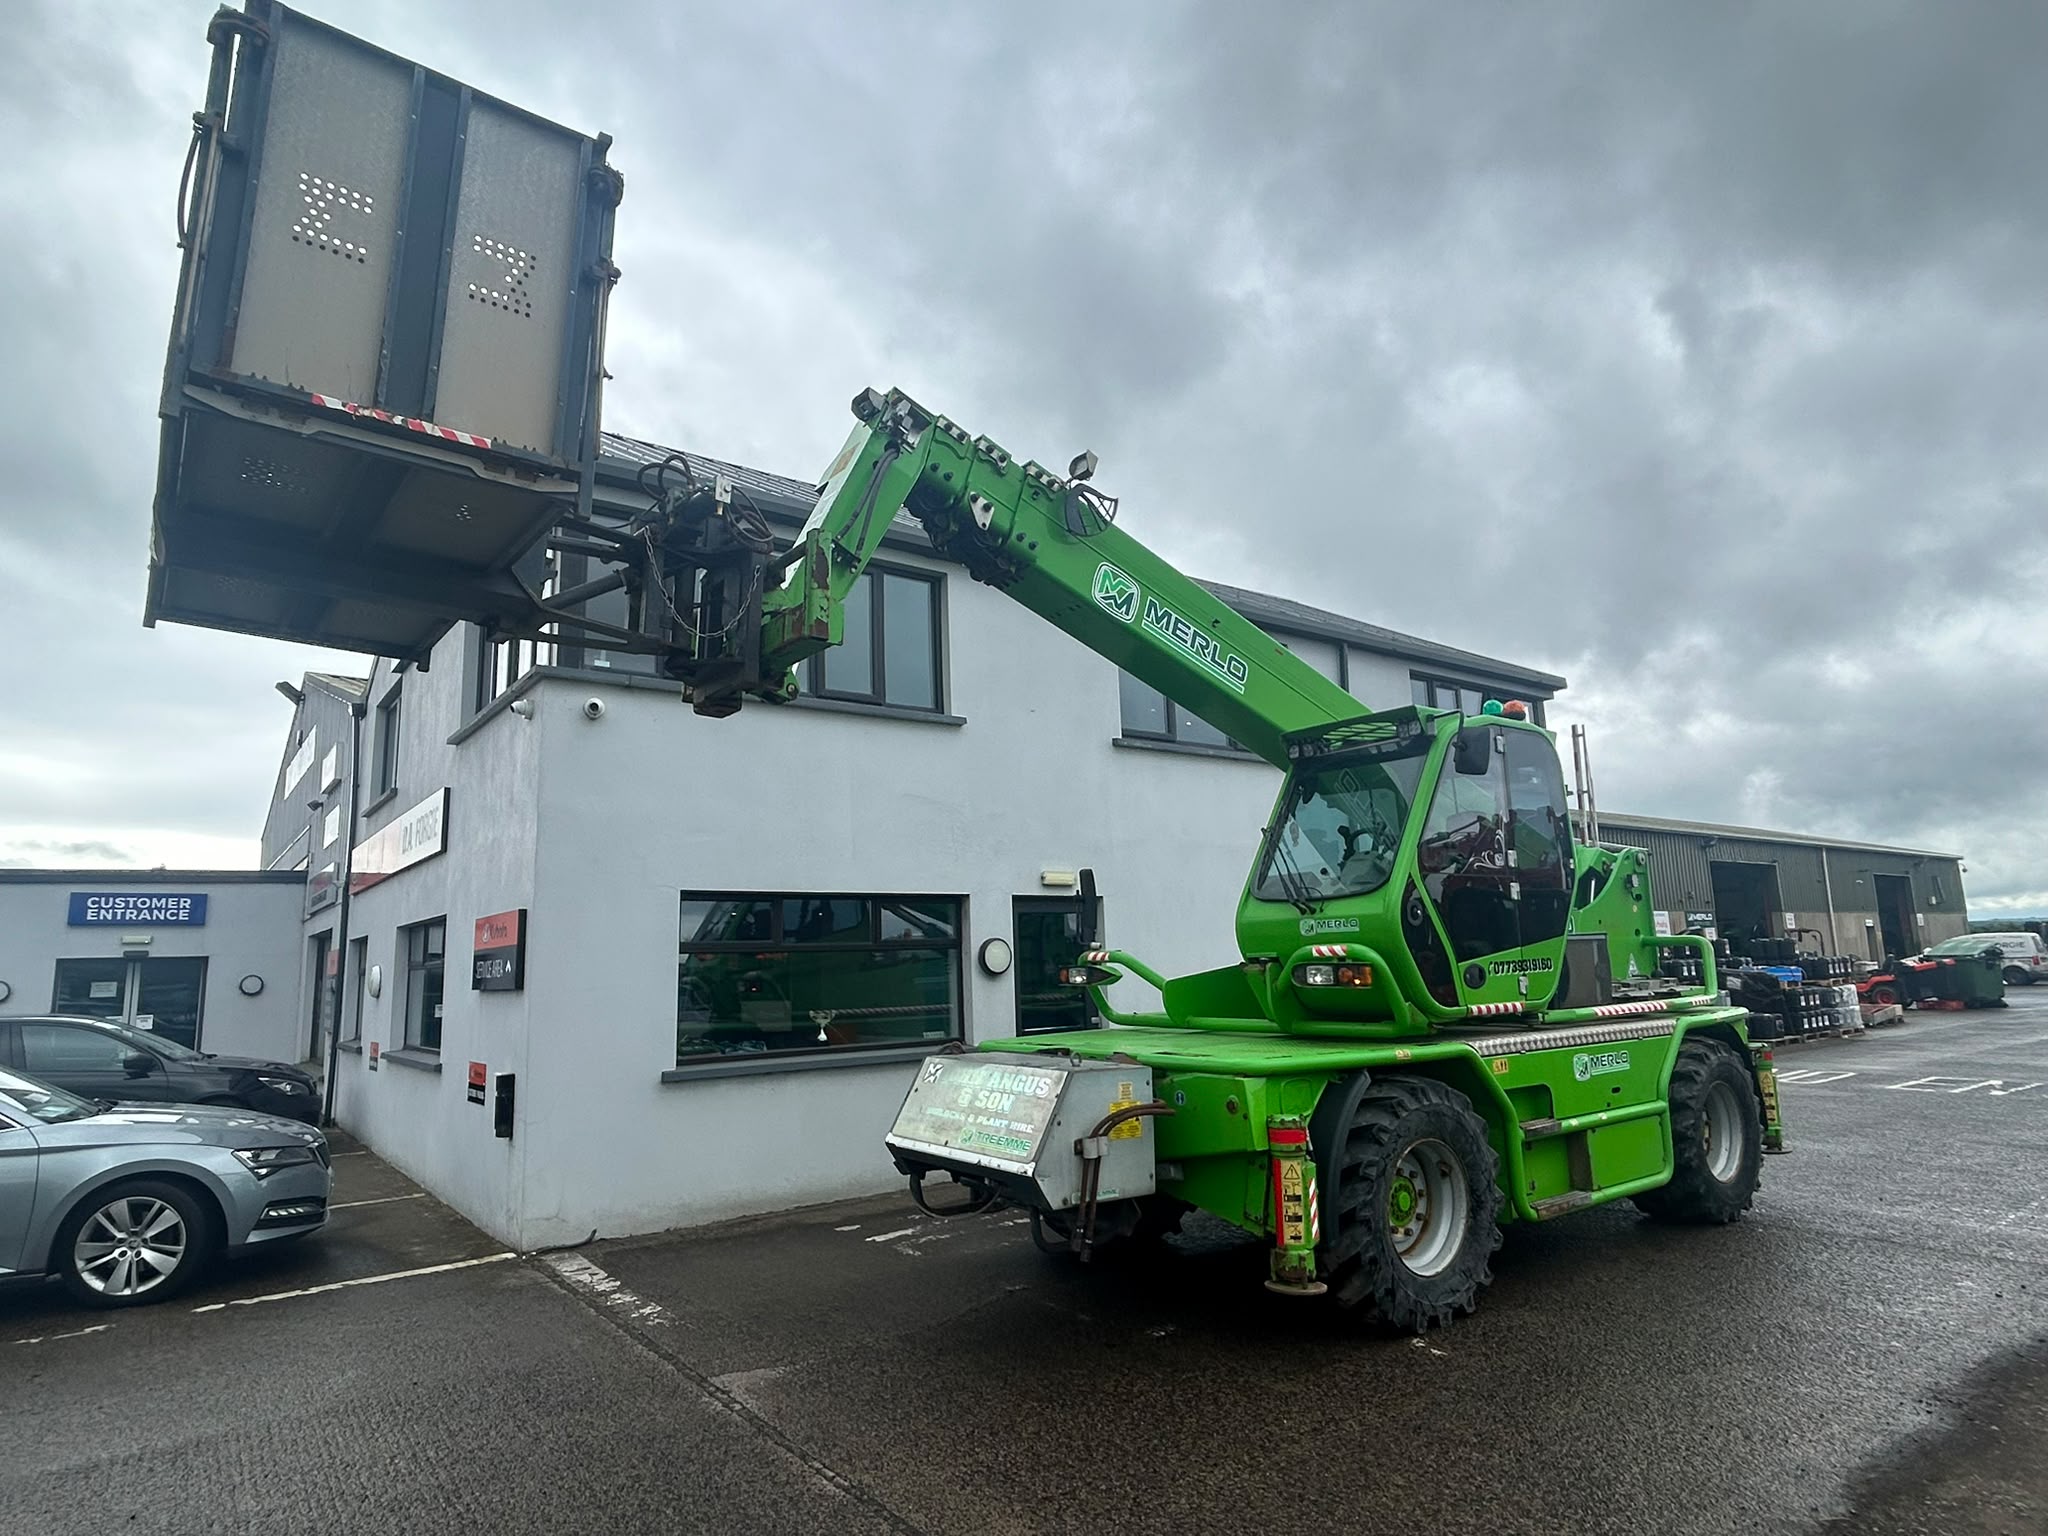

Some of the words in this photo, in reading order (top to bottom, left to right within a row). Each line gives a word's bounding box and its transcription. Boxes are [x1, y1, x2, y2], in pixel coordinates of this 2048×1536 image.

[1144, 596, 1248, 683] MERLO
[86, 897, 192, 909] CUSTOMER
[86, 909, 190, 920] ENTRANCE
[1317, 919, 1359, 929] MERLO
[1590, 1051, 1629, 1068] MERLO
[985, 1071, 1052, 1098] ANGUS
[974, 1090, 1017, 1114] SON
[976, 1115, 1009, 1128] PLANT
[1009, 1121, 1035, 1134] HIRE
[975, 1130, 1032, 1151] TREEMME
